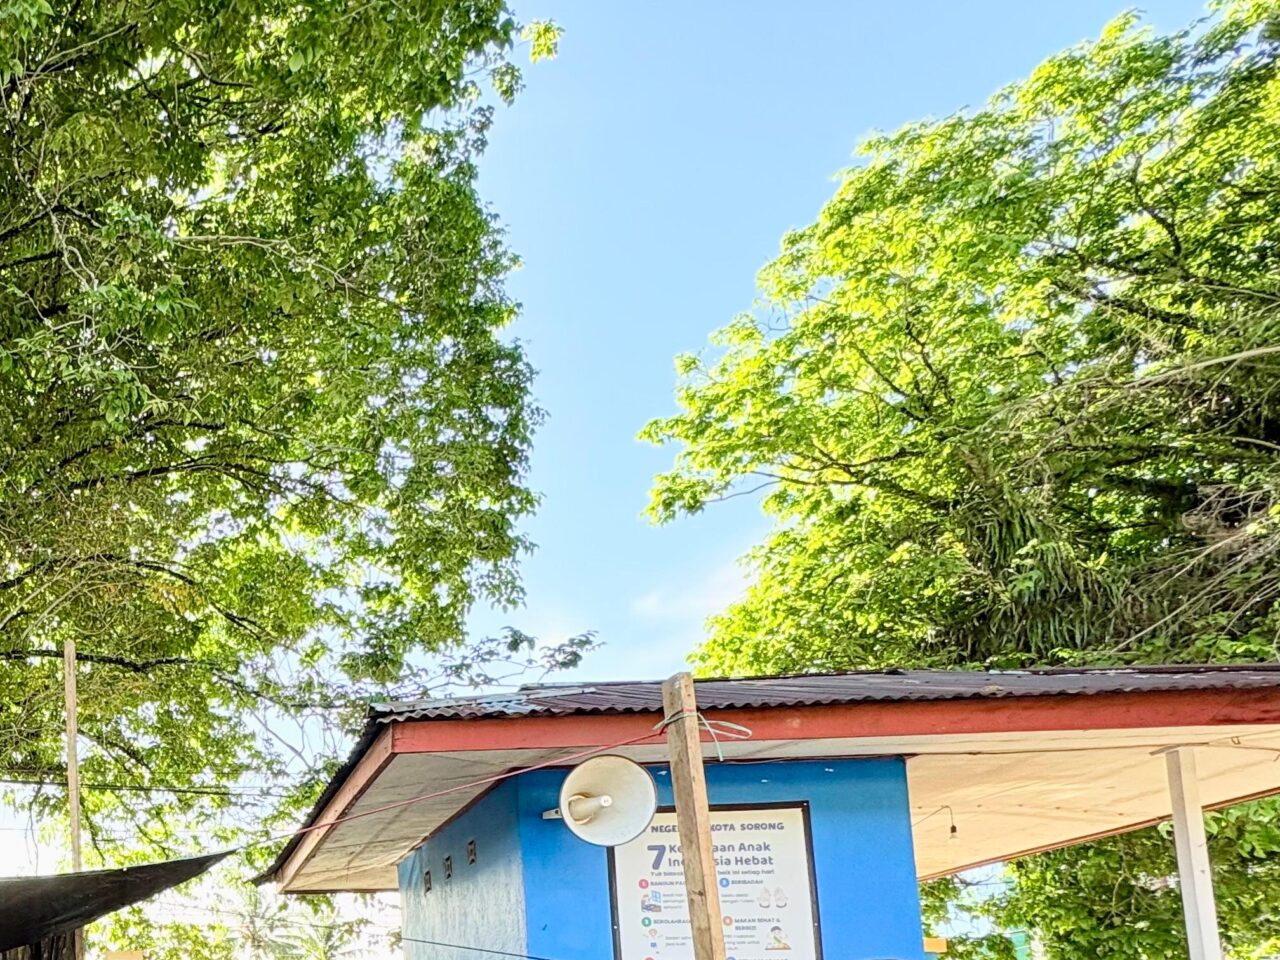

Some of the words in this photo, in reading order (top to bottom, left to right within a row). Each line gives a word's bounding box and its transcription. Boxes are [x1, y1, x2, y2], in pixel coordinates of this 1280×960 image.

[650, 825, 680, 833] NEGE
[740, 822, 785, 831] SORONG
[738, 841, 771, 852] Anak
[647, 844, 666, 870] 7
[735, 855, 774, 866] Hebat
